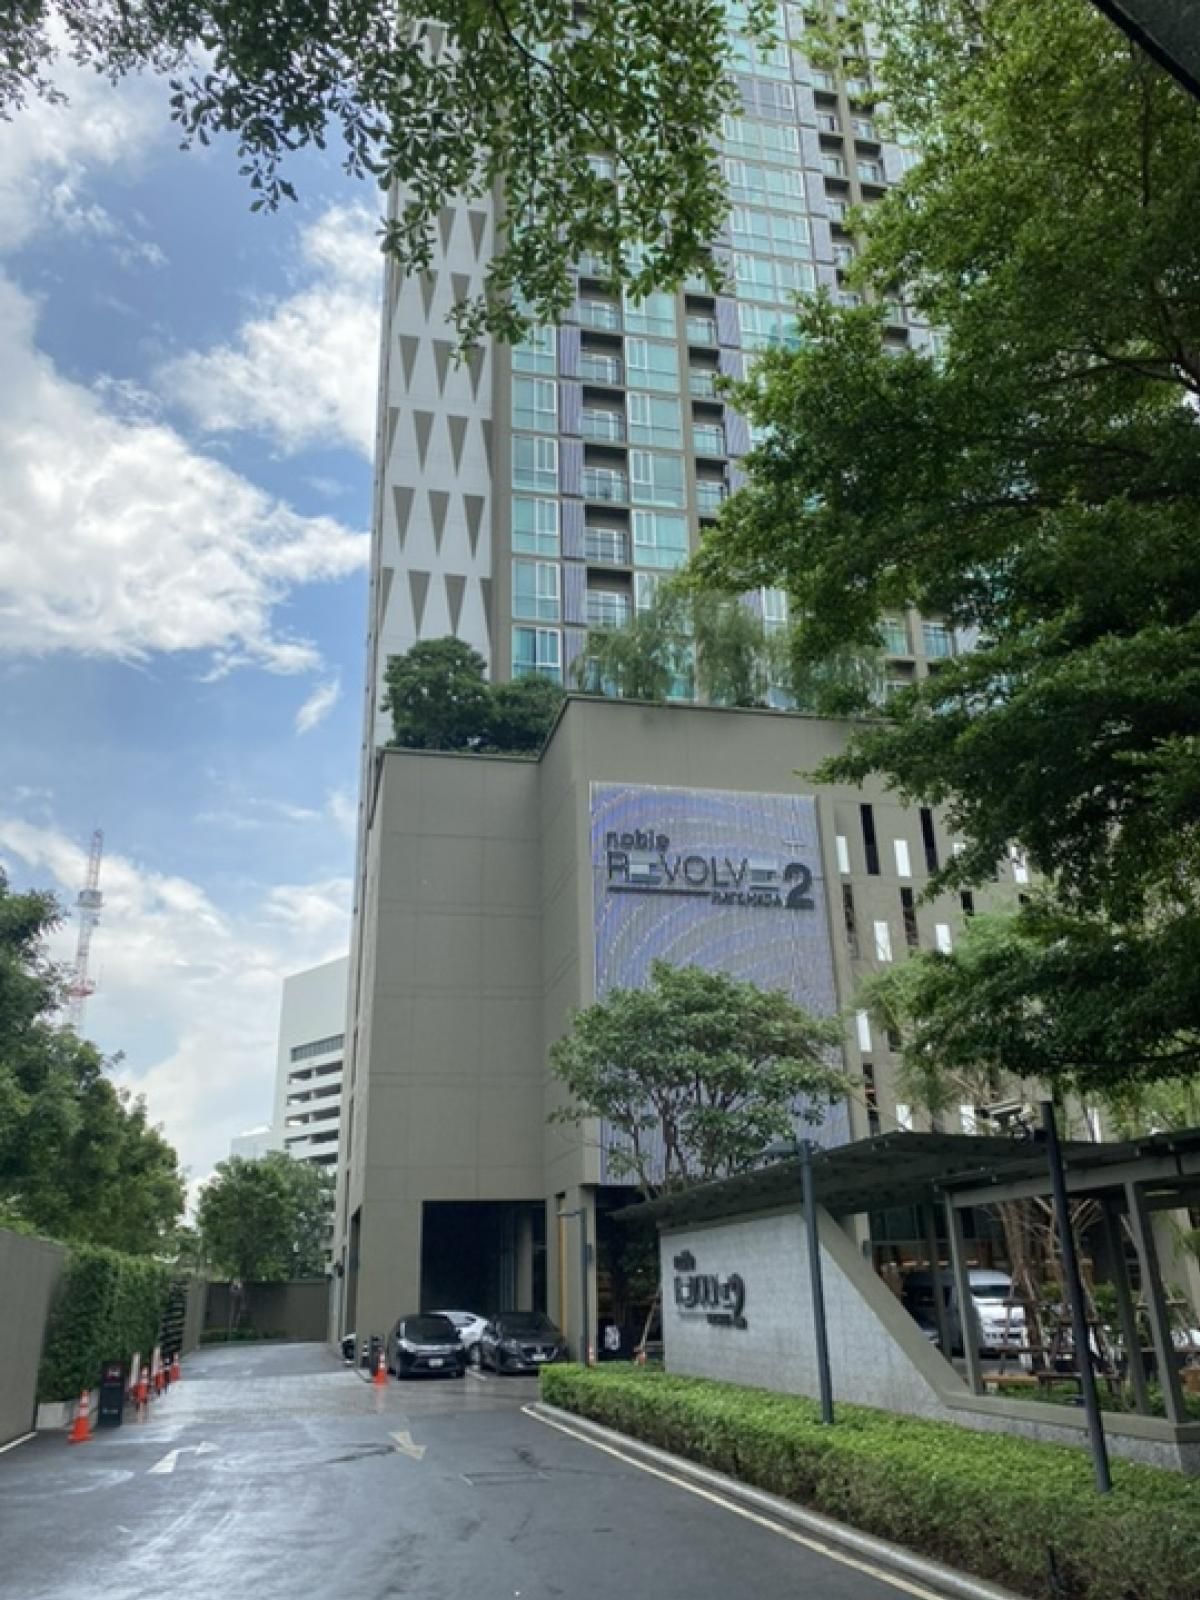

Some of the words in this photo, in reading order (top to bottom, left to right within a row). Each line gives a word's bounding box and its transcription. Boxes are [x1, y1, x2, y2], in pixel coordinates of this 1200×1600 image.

[606, 829, 670, 851] noble
[606, 851, 779, 890] REVOLVE
[783, 862, 815, 910] 2
